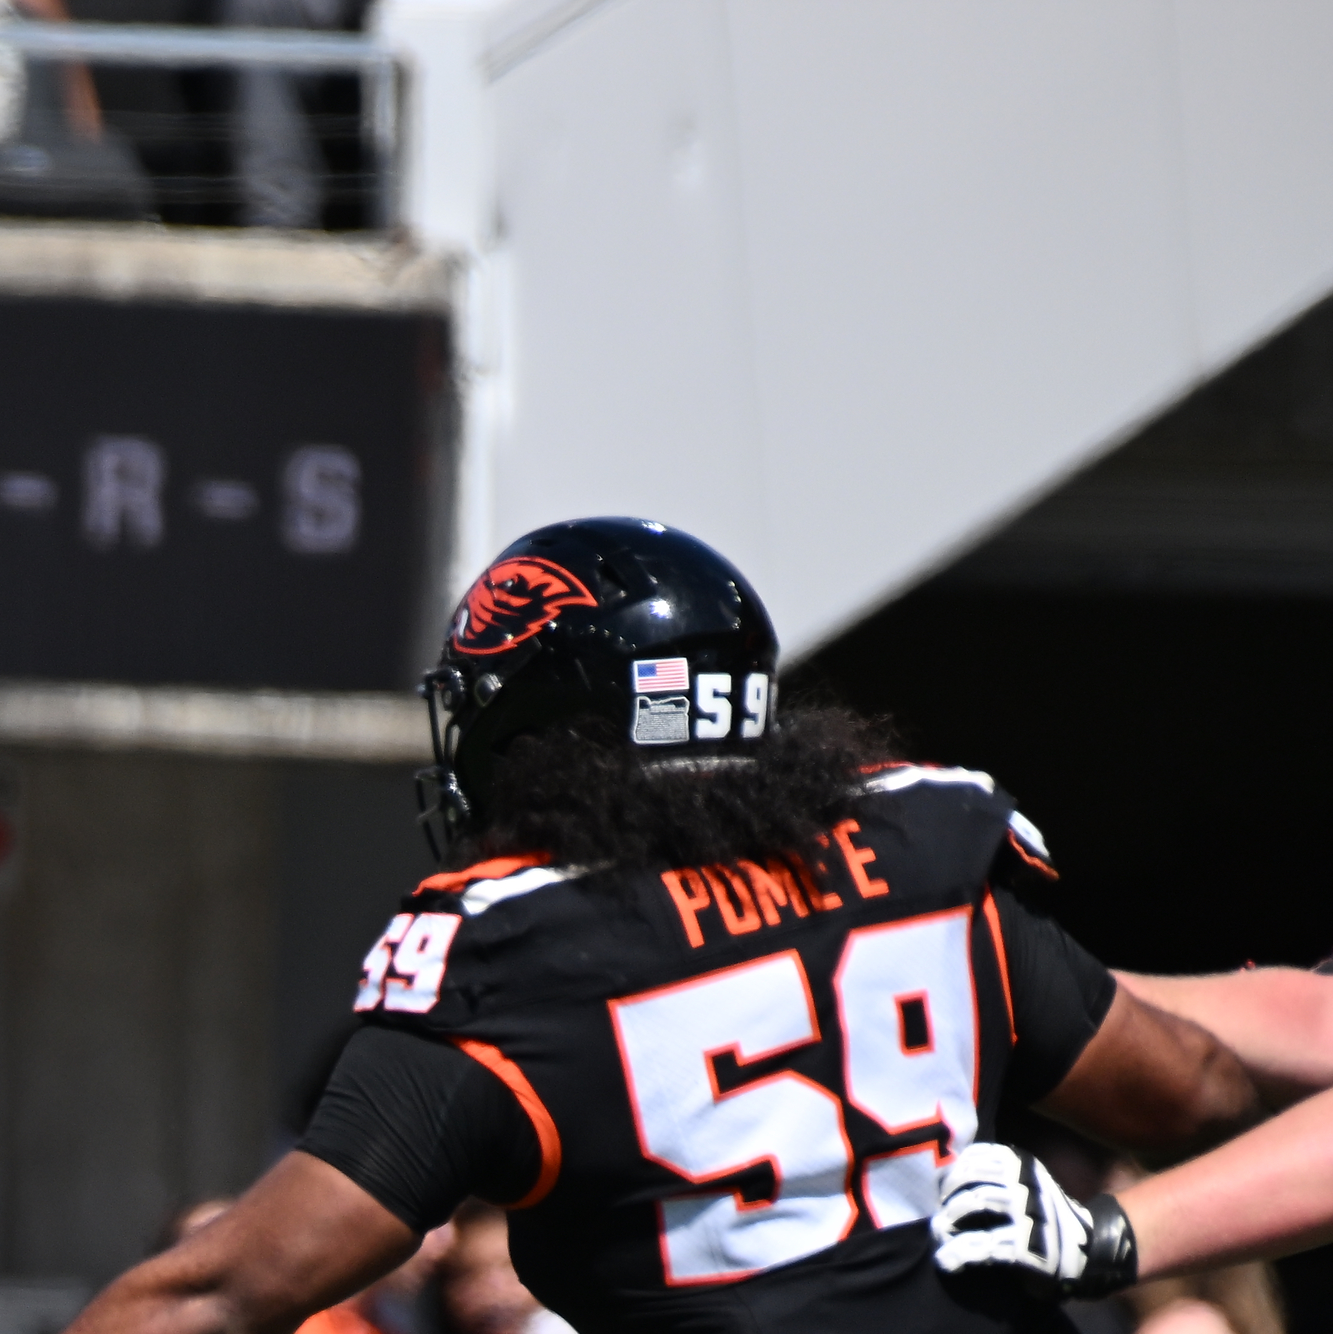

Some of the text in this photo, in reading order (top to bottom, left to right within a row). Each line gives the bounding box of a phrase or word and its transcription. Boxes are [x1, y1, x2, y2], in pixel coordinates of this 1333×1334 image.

[696, 672, 769, 739] 59
[353, 911, 463, 1014] 59
[608, 904, 980, 1288] 59
